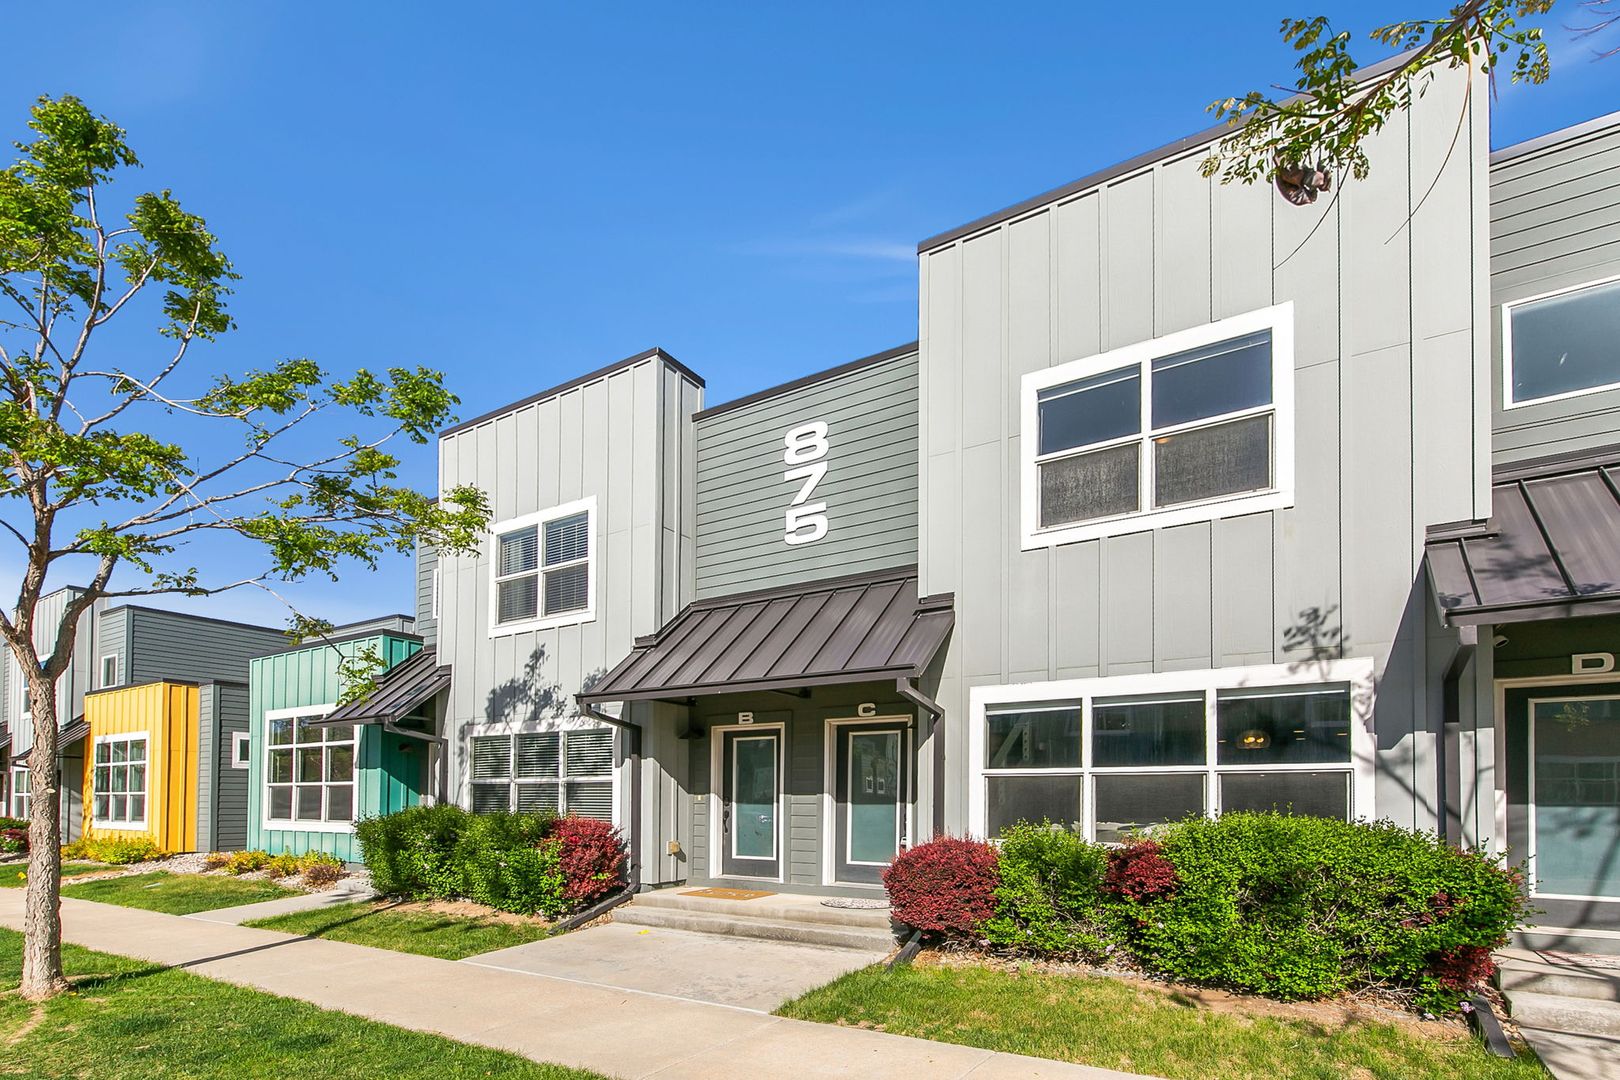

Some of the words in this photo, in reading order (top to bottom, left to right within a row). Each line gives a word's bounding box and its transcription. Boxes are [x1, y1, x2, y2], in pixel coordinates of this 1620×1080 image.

[784, 421, 829, 545] 875
[1572, 652, 1615, 674] D
[738, 712, 754, 725] B
[858, 703, 876, 717] C
